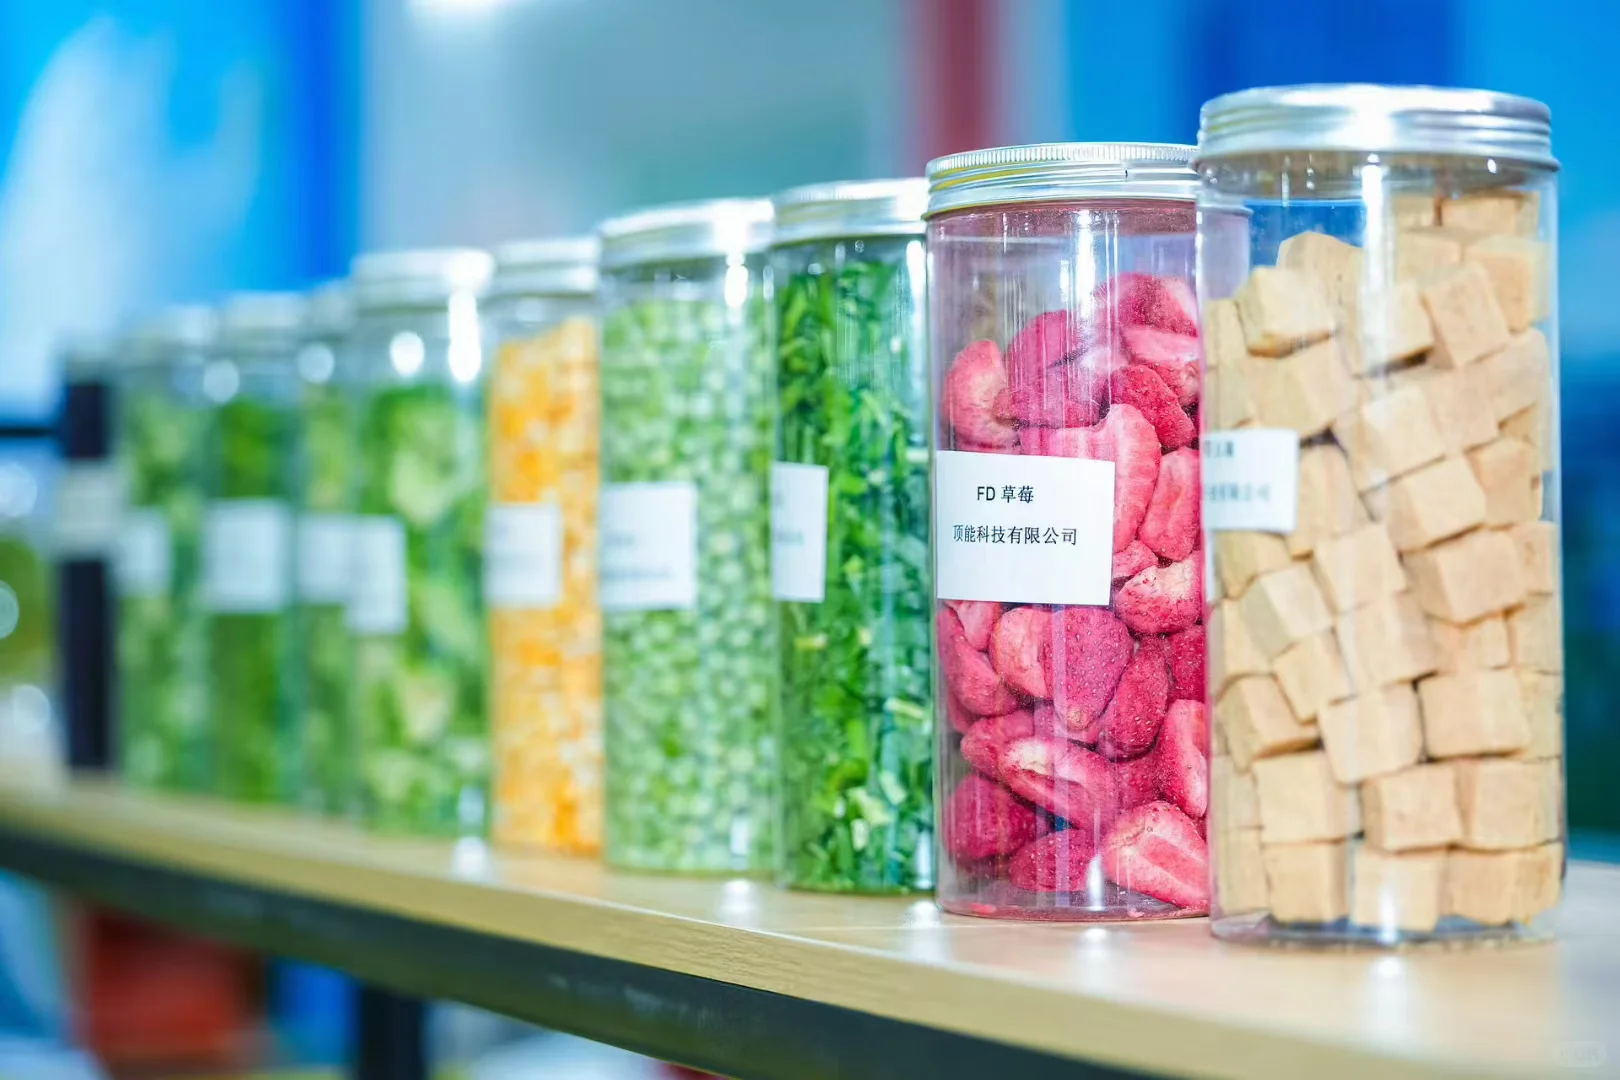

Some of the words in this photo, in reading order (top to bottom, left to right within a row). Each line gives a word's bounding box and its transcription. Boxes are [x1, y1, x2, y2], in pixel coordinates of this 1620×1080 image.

[977, 486, 996, 501] FD
[1001, 485, 1034, 504] 草莓
[953, 524, 1077, 546] 顶能科技有限公司
